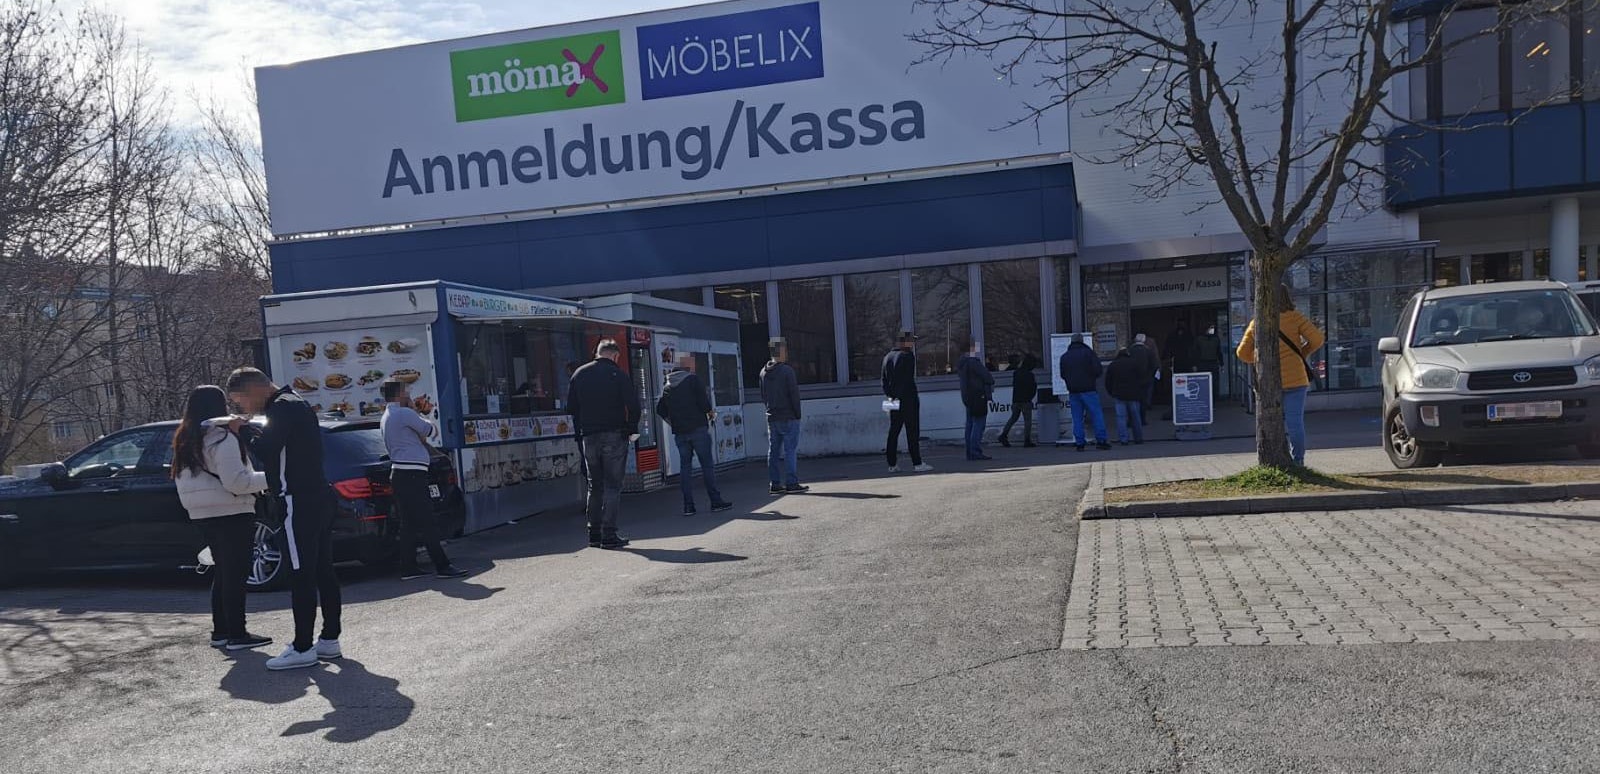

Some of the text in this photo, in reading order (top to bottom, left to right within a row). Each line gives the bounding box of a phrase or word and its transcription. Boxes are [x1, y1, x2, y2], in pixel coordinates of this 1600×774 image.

[647, 25, 814, 79] MÖBELIX
[382, 98, 926, 199] Anmeldung/Kassa
[1135, 282, 1185, 294] Anmeldung
[1196, 279, 1221, 288] Kassa
